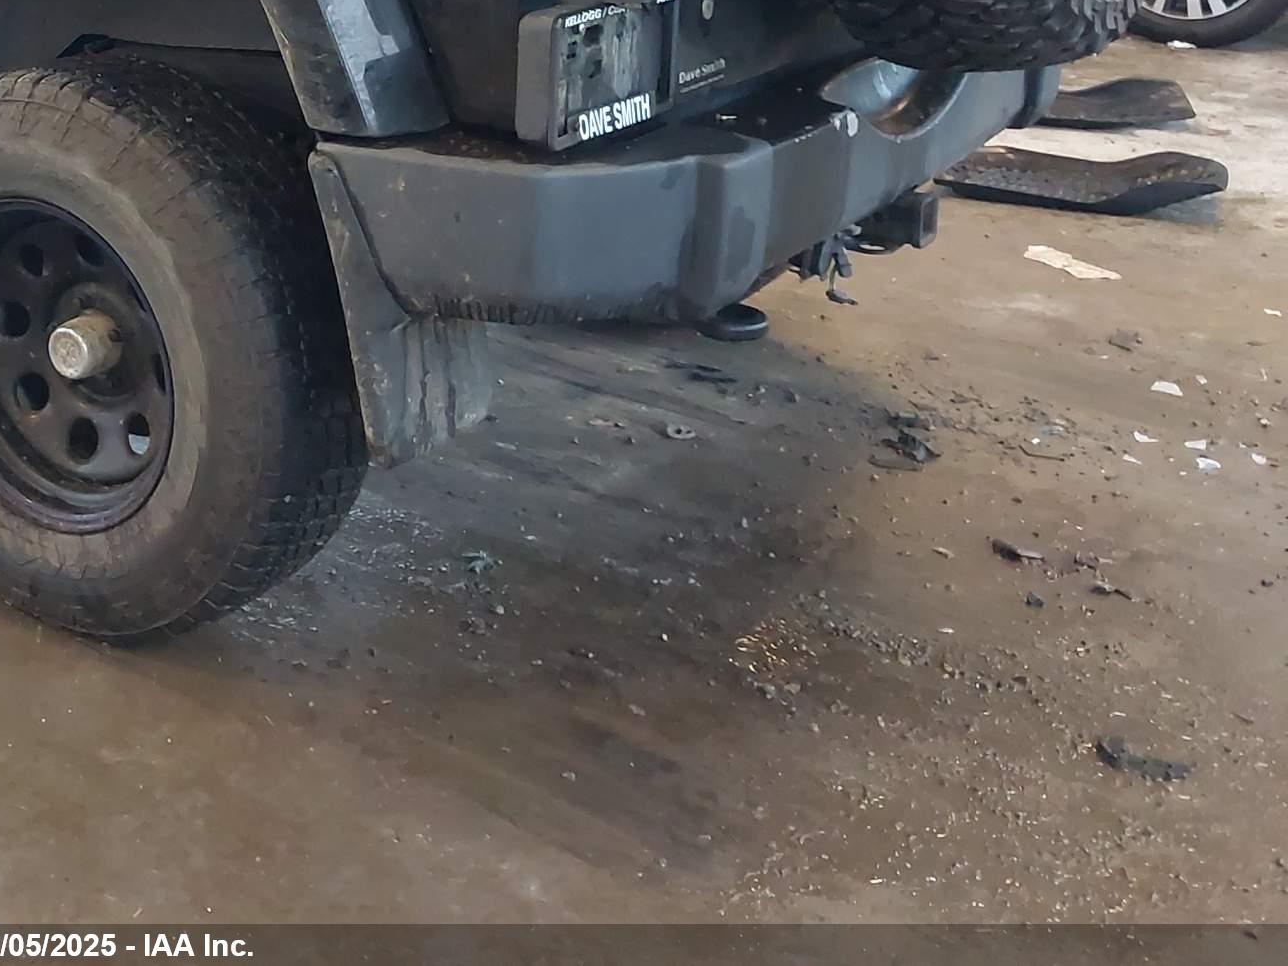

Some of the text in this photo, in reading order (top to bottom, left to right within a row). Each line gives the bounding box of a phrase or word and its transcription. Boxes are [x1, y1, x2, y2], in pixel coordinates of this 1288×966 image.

[565, 8, 602, 28] KELLOGG
[578, 93, 651, 141] DAVE SMITH
